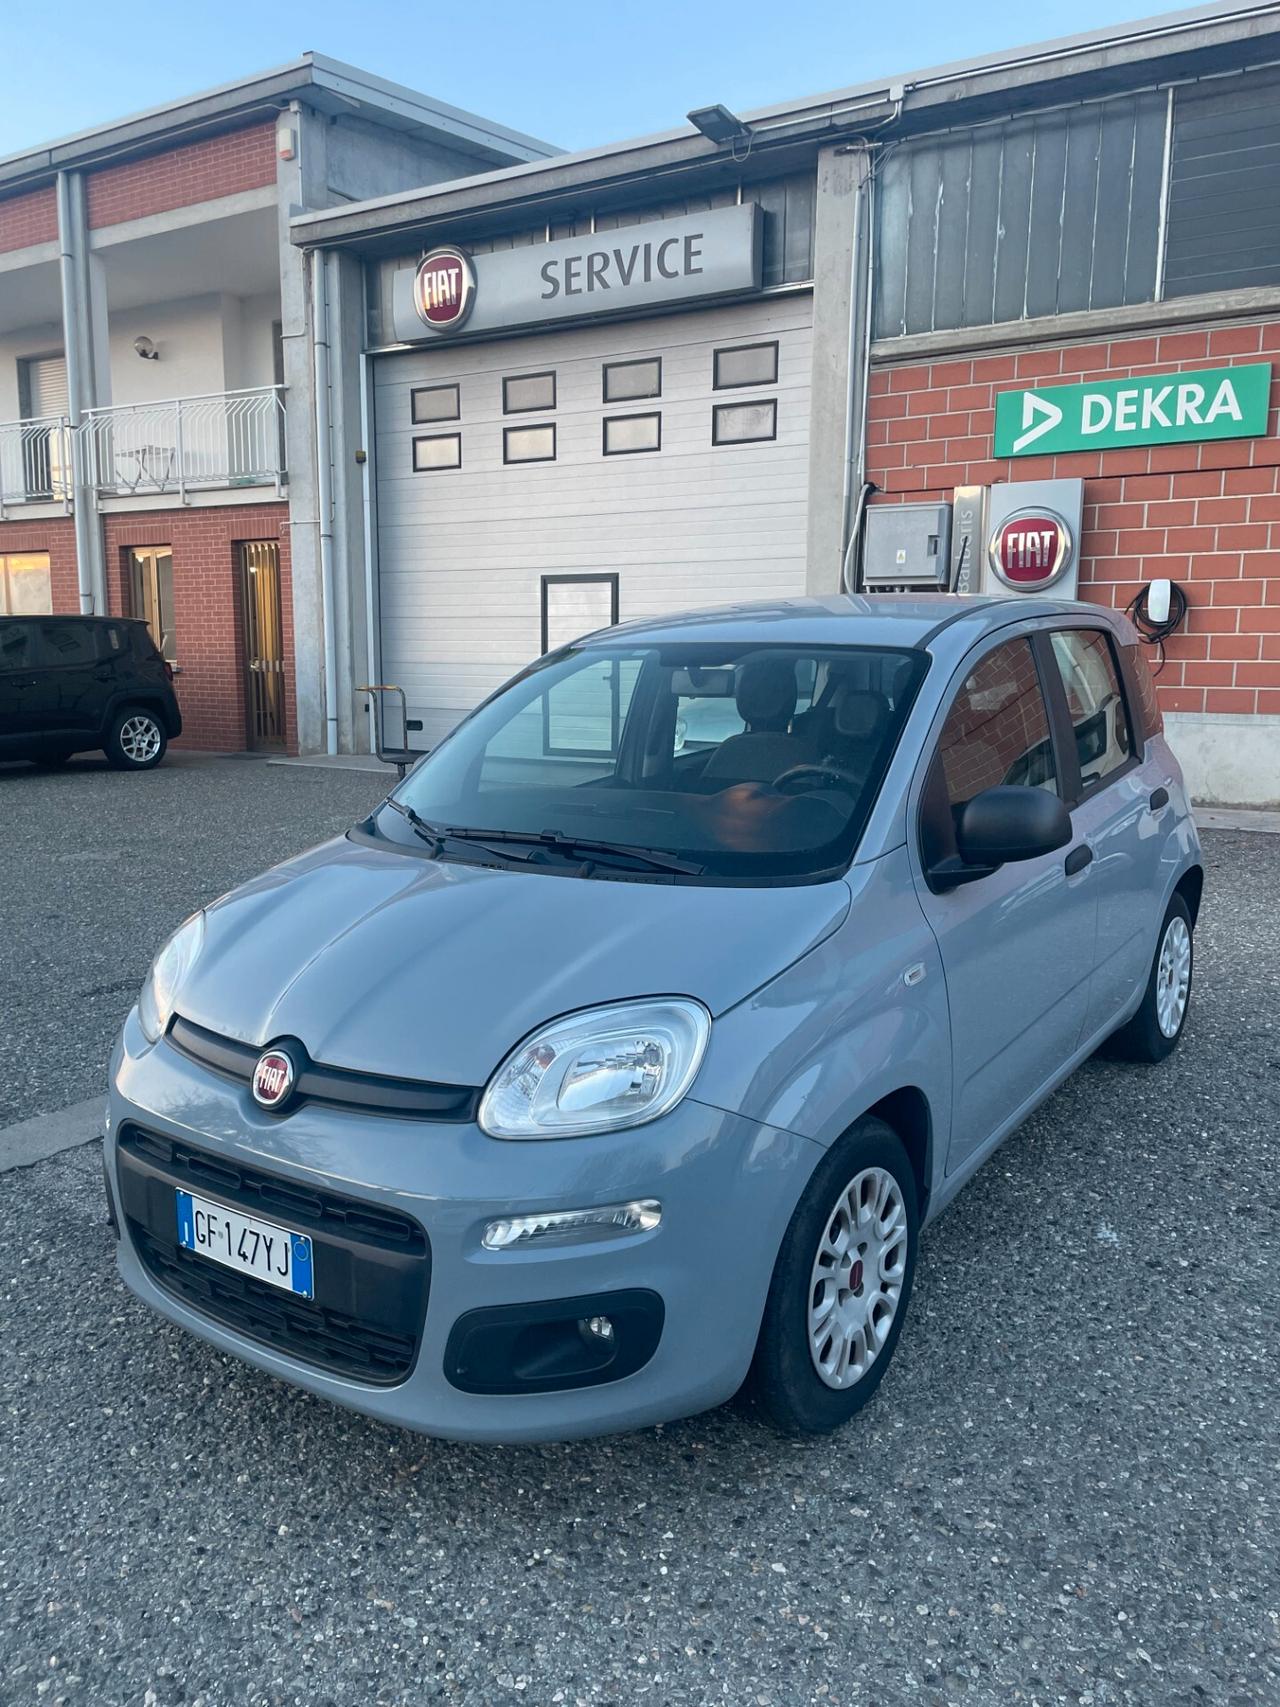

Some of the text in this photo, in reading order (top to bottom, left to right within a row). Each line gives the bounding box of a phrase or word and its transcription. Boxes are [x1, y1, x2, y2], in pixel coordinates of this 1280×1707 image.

[423, 233, 704, 310] FIAT SERVICE
[1081, 379, 1243, 435] DEKRA
[1007, 531, 1055, 568] FIAT
[259, 1065, 285, 1093] FIAT
